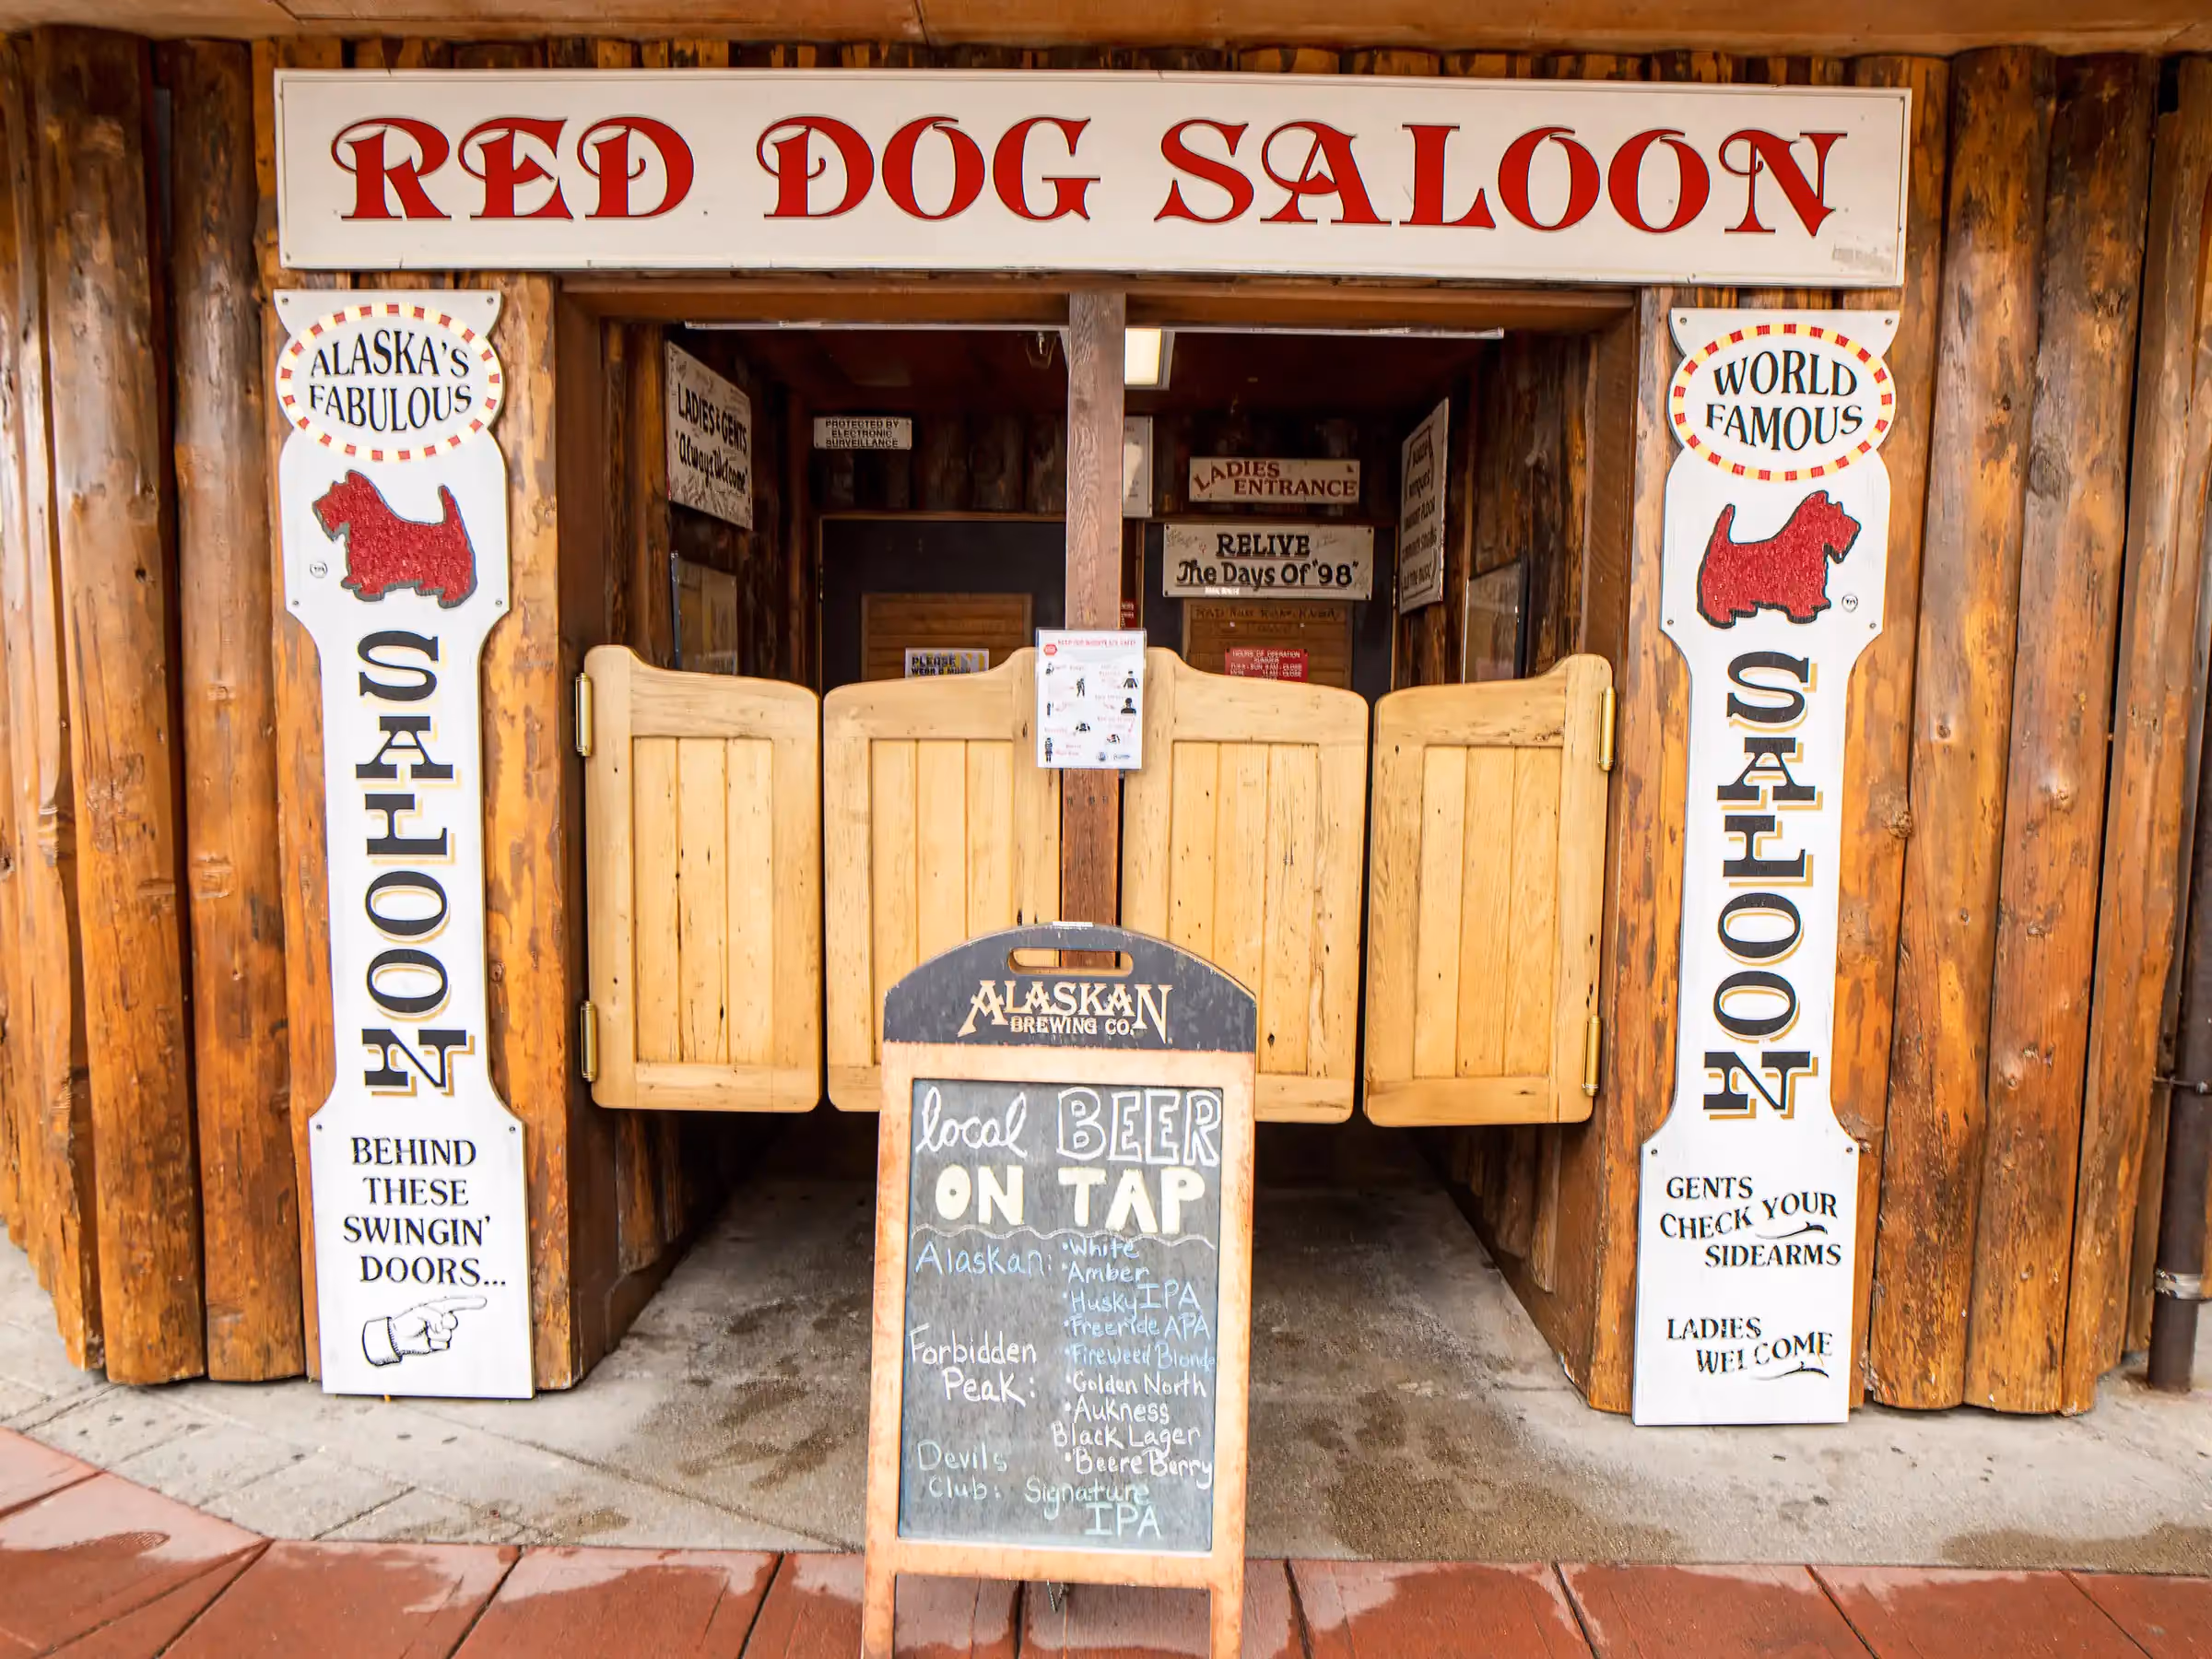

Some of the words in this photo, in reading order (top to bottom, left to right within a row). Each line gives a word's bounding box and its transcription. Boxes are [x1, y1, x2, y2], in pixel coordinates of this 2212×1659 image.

[331, 114, 695, 221] RED
[756, 114, 1100, 222] DOG
[1154, 118, 1847, 238] SALOON
[310, 329, 470, 378] ALASKA'S
[1713, 349, 1858, 396] WORLD
[310, 384, 472, 432] FABULOUS
[677, 383, 714, 436] LADIES
[722, 410, 747, 455] GENTS
[825, 419, 883, 429] PROTECTED
[885, 419, 900, 429] BY
[825, 438, 899, 448] SURVEILLANCE
[831, 429, 893, 438] ELECTRONIC
[1705, 404, 1863, 451] FAMOUS
[1194, 461, 1280, 492] LADIES
[1233, 478, 1358, 497] ENTRANCE
[1216, 533, 1311, 557] RELIVE
[1176, 558, 1218, 584] The
[1221, 561, 1276, 591] Days
[1280, 560, 1311, 585] Of
[356, 630, 471, 1091] SALOON
[1703, 651, 1819, 1114] SALOON
[957, 980, 1173, 1043] ALASKAN
[1009, 1016, 1098, 1035] BREWING
[1104, 1018, 1135, 1036] CO.
[915, 1086, 1029, 1159] local
[1056, 1086, 1222, 1167] BEER
[350, 1136, 477, 1167] BEHIND
[362, 1177, 469, 1206] THESE
[935, 1164, 1025, 1227] ON
[1058, 1167, 1206, 1234] TAP
[1665, 1175, 1754, 1199] GENTS
[343, 1215, 491, 1246] SWINGIN'
[1659, 1206, 1754, 1240] CHECK
[1761, 1192, 1839, 1220] YOUR
[1069, 1237, 1140, 1259] White
[1705, 1243, 1841, 1268] SIDEARMS
[359, 1255, 507, 1287] DOORS...
[1068, 1260, 1150, 1284] Amber
[1070, 1287, 1138, 1322] Husky
[1136, 1278, 1203, 1312] IPA
[1164, 1312, 1211, 1341] APA
[1666, 1316, 1761, 1341] LADIES
[908, 1322, 1038, 1366] Forbidden
[1696, 1331, 1833, 1374] WELCOME
[1073, 1369, 1139, 1395] Golden
[1143, 1370, 1206, 1398] North
[916, 1438, 1008, 1472] Devils
[1051, 1420, 1125, 1449] Black
[1128, 1423, 1201, 1458] Lager
[1073, 1446, 1143, 1475] Beere
[1141, 1446, 1213, 1489] Berry
[1024, 1474, 1150, 1521] Signature
[1083, 1500, 1162, 1540] IPA
